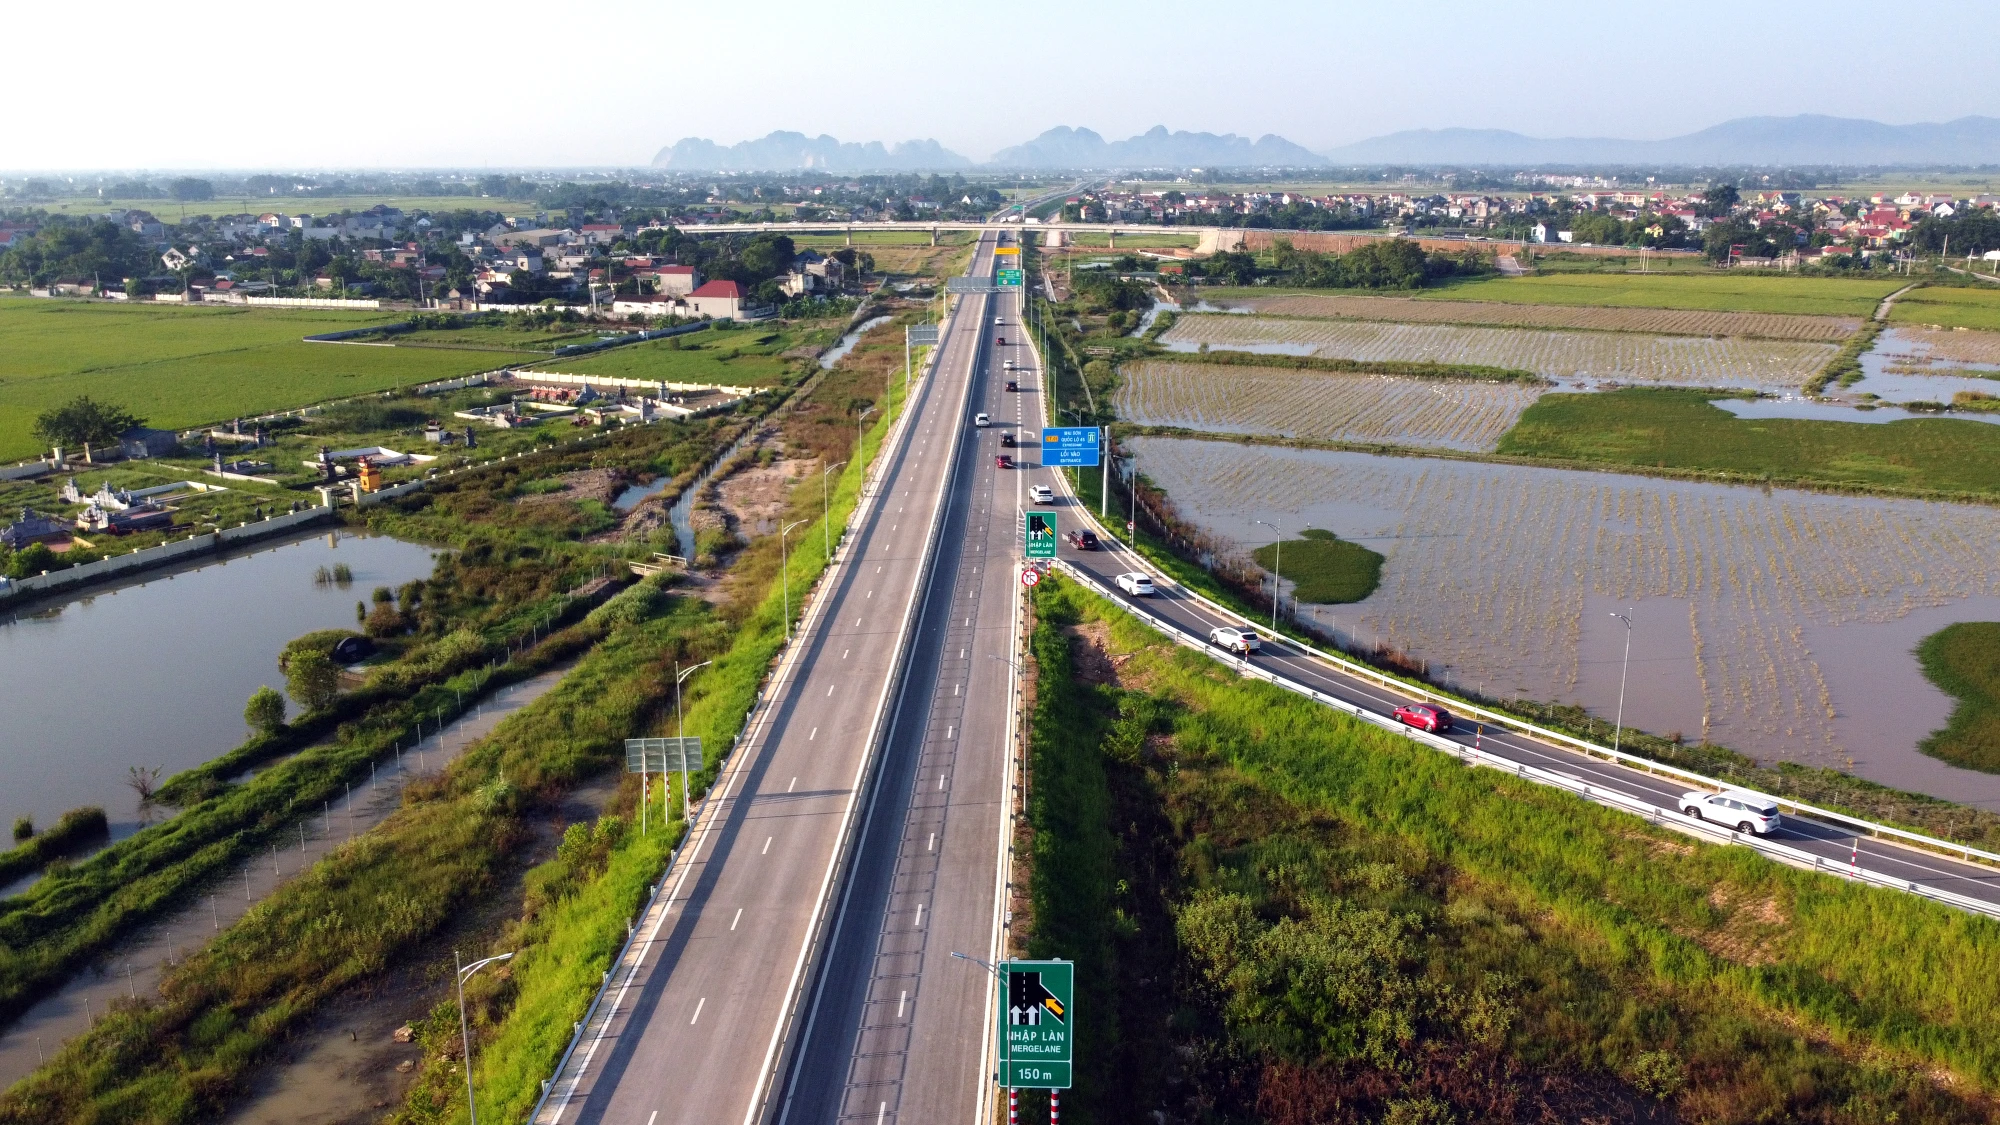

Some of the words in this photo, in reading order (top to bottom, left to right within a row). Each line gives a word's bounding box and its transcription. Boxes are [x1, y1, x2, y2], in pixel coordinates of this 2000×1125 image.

[1042, 1029, 1064, 1042] LÀN
[1011, 1045, 1061, 1053] MERGELANE
[1018, 1068, 1039, 1080] 150
[1043, 1072, 1052, 1080] m
